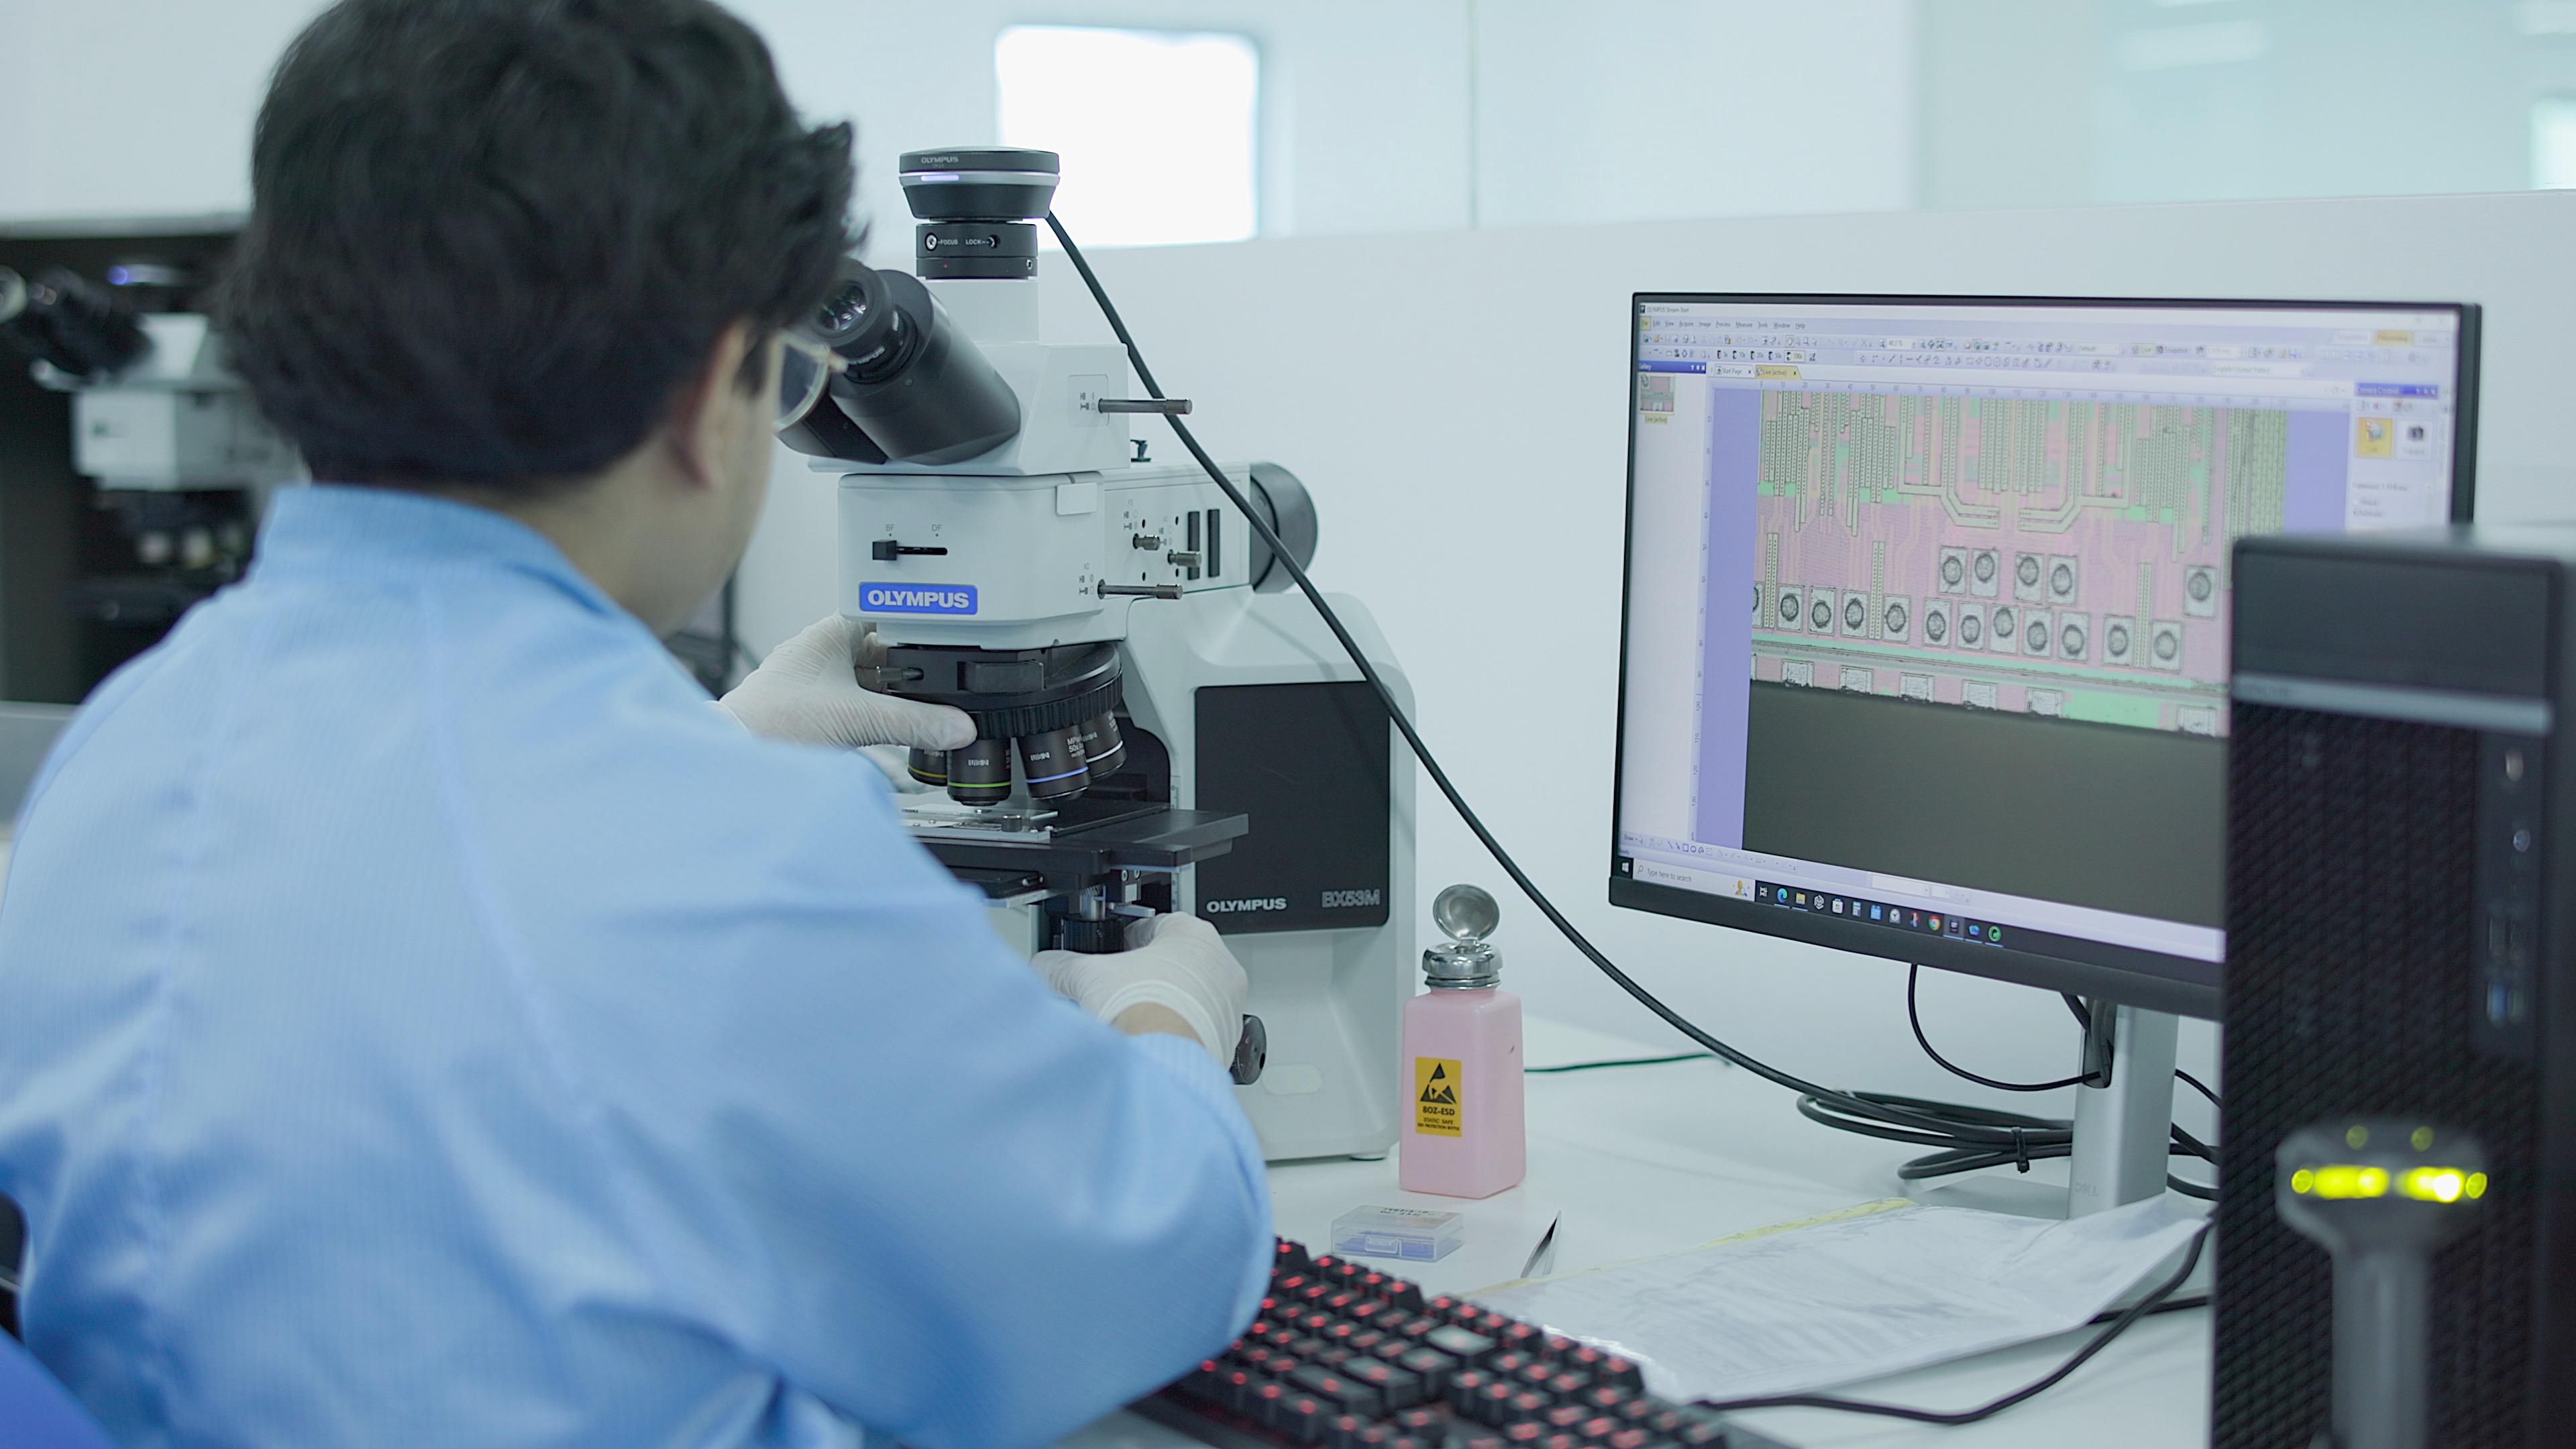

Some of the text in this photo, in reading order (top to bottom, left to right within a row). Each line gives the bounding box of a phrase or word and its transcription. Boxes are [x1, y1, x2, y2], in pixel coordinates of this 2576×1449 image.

[920, 156, 959, 164] OLYMPUS
[867, 590, 969, 608] OLYMPUS
[1647, 867, 1658, 877] Type
[1659, 871, 1670, 879] here
[1206, 898, 1287, 913] OLYMPUS
[1322, 889, 1381, 908] BX53M
